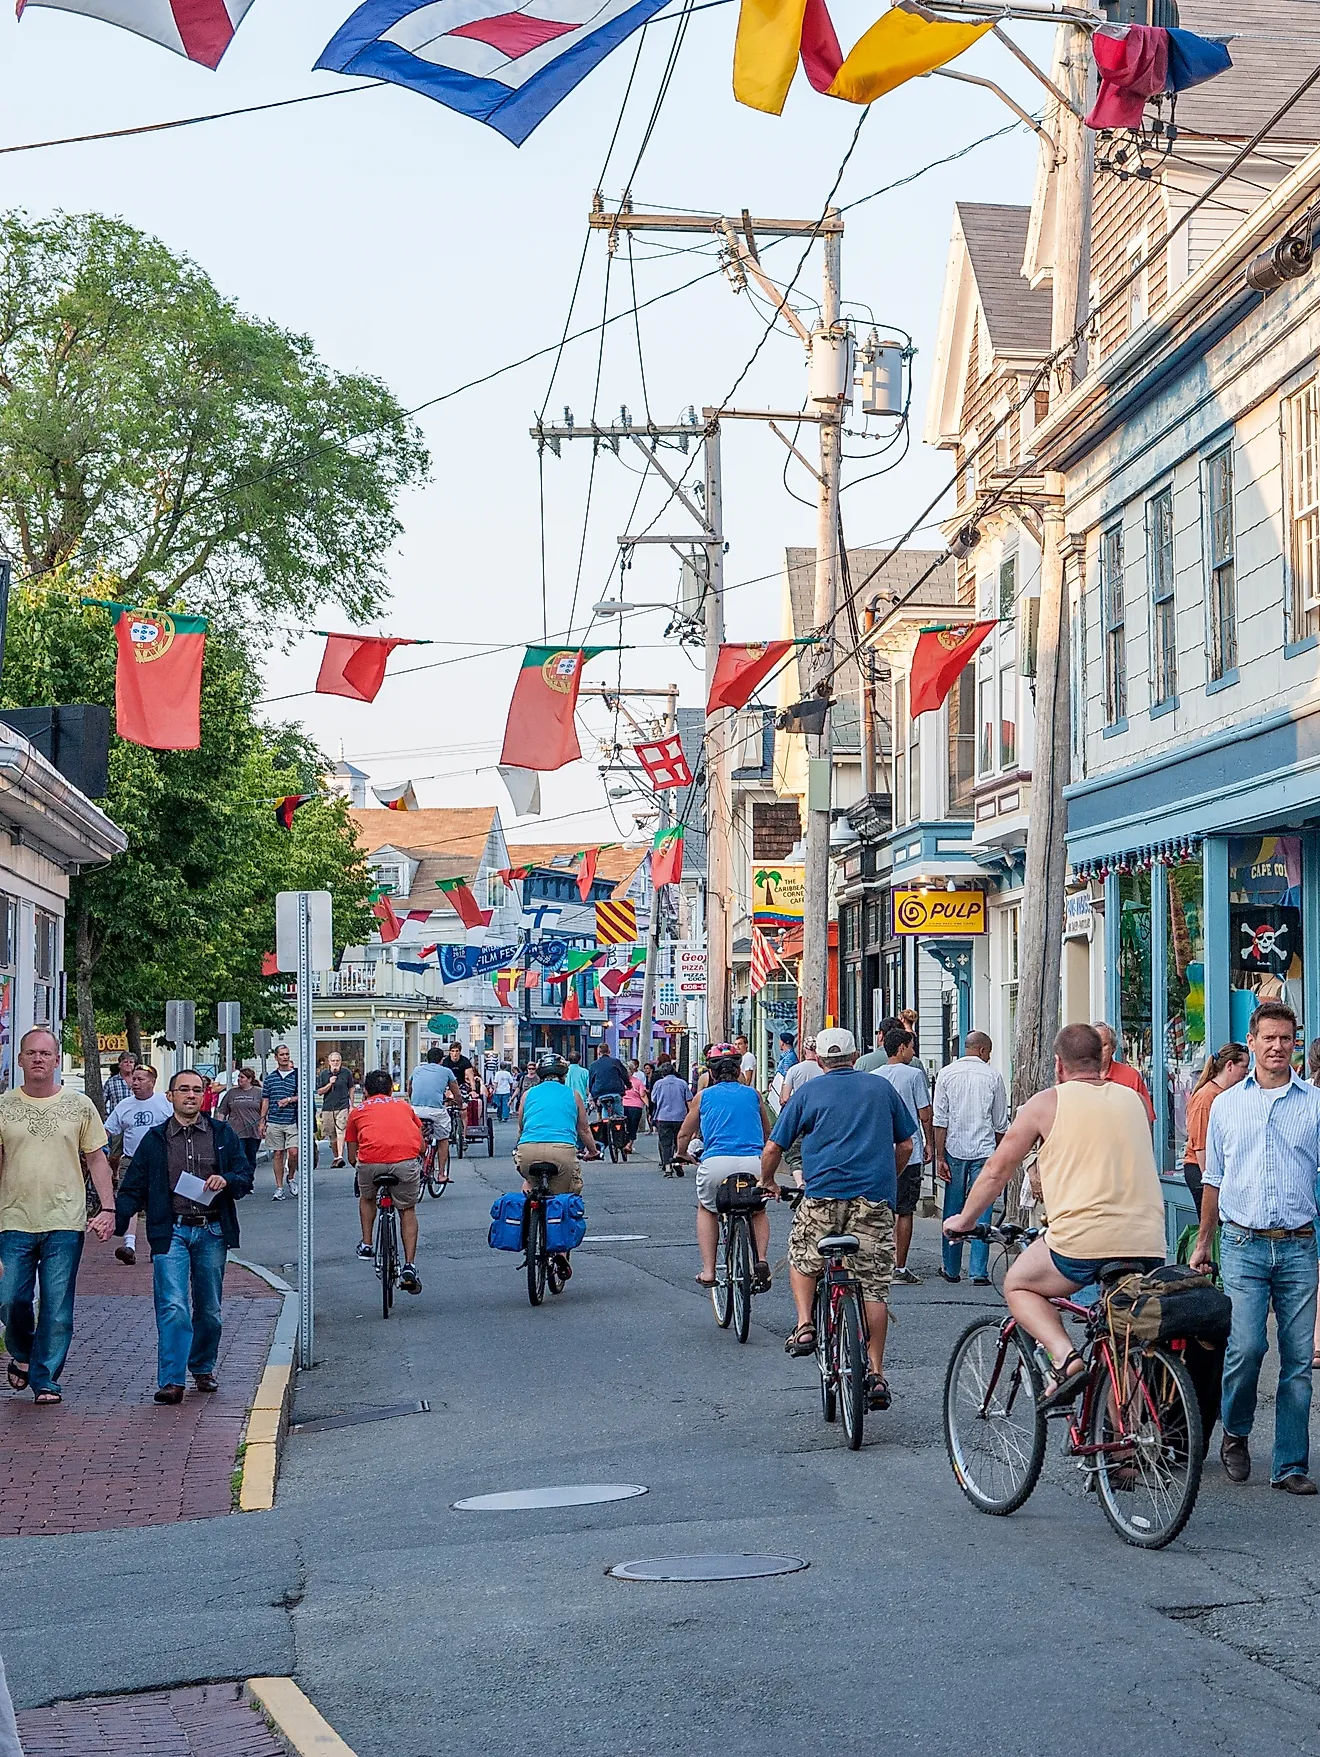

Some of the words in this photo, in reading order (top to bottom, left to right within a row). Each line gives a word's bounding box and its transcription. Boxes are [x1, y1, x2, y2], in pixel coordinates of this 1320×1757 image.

[1251, 864, 1272, 879] CAPE
[774, 885, 804, 893] CARIBBEA
[930, 902, 982, 919] PULP
[476, 951, 498, 967] FILM
[97, 1036, 127, 1051] DGE
